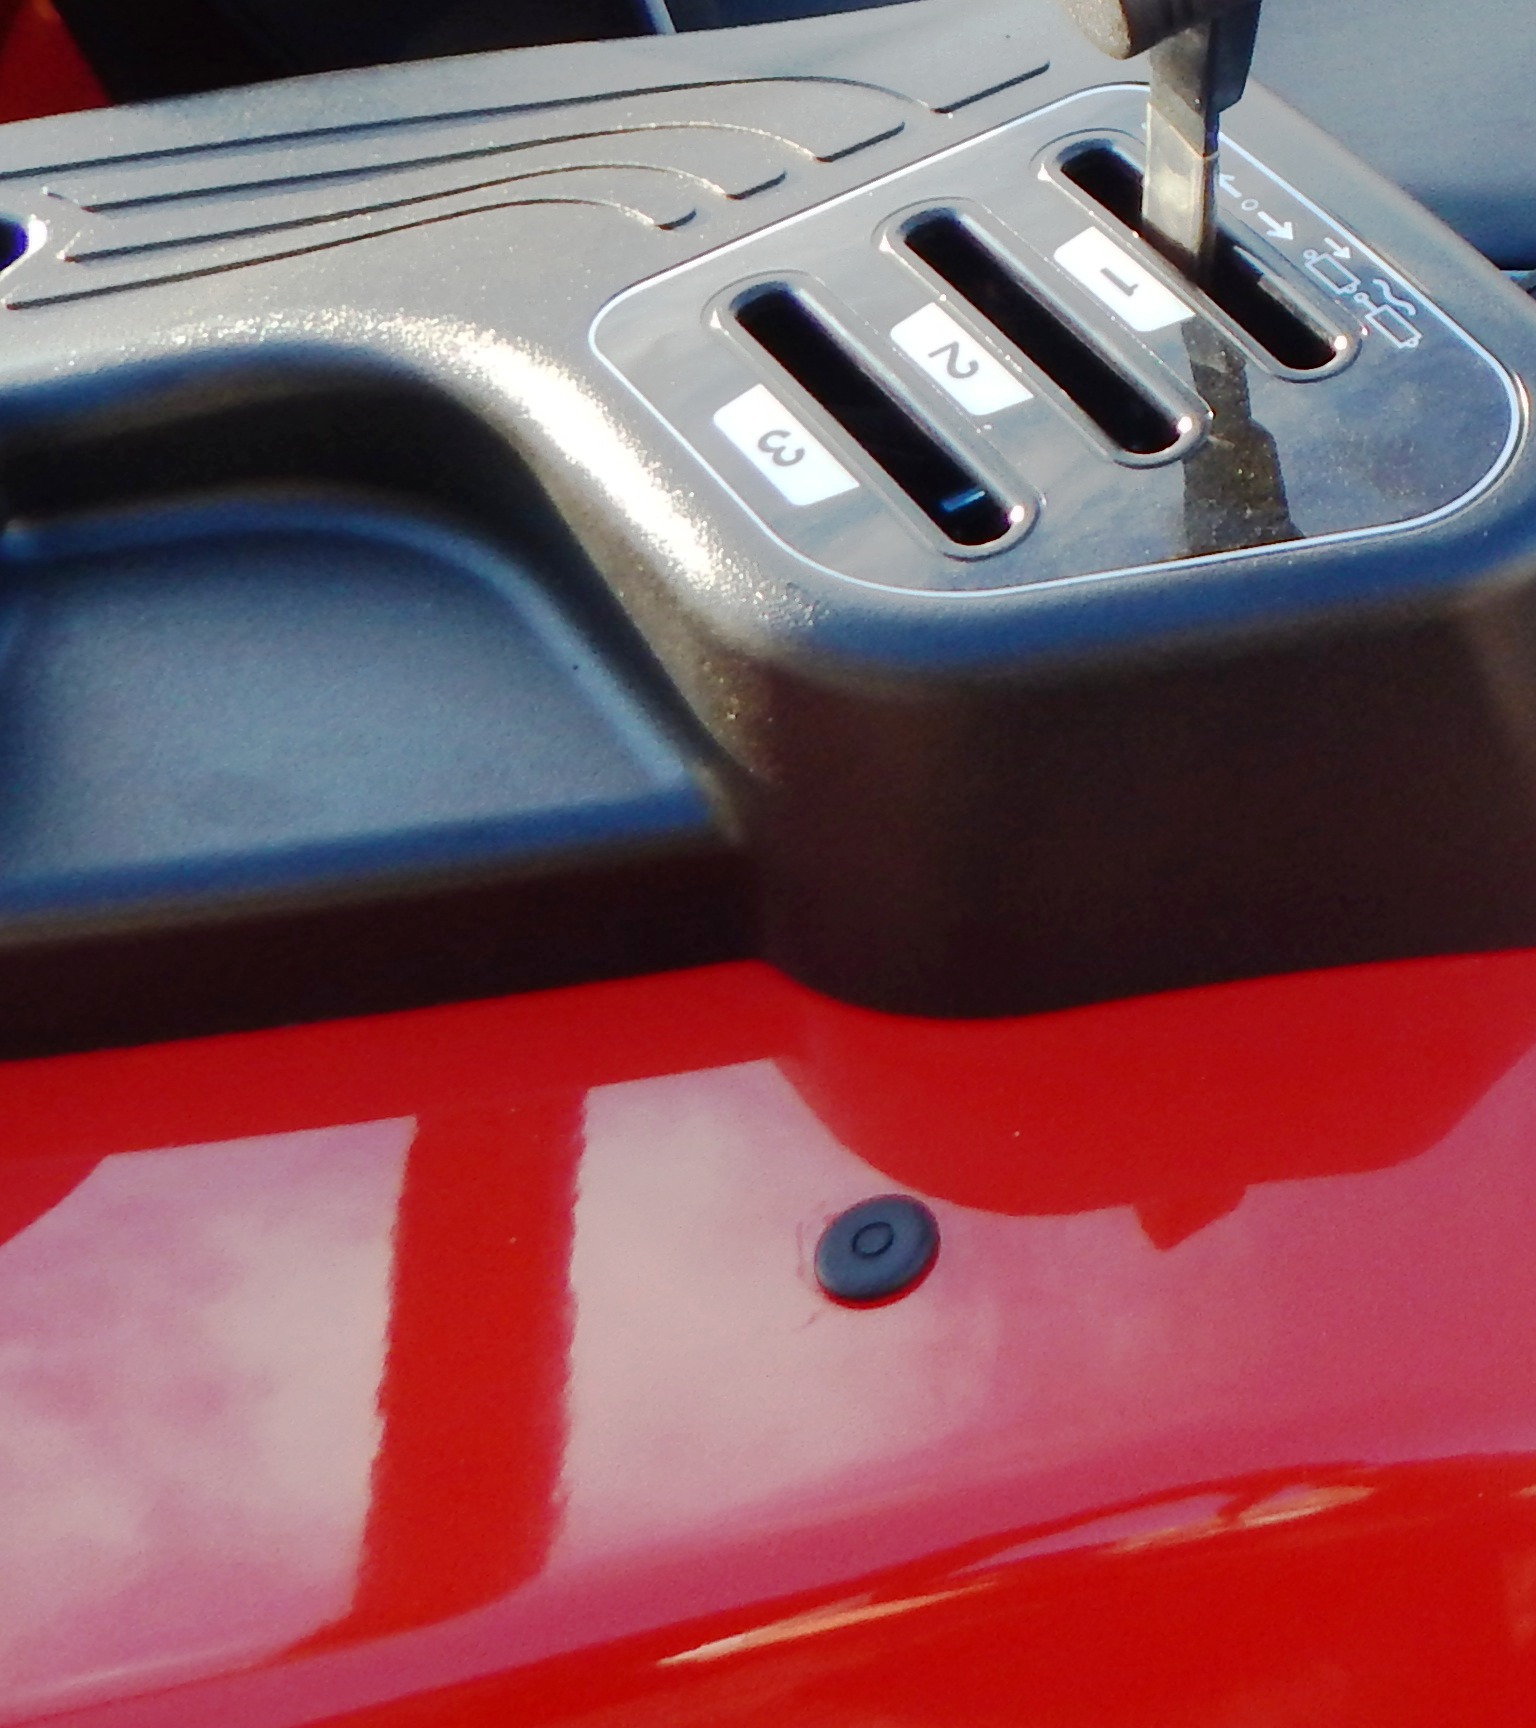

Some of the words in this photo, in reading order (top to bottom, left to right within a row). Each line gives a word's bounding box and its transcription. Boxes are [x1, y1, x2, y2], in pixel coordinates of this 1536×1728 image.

[1099, 266, 1140, 296] 1
[928, 338, 980, 383] 2
[757, 429, 806, 468] 3
